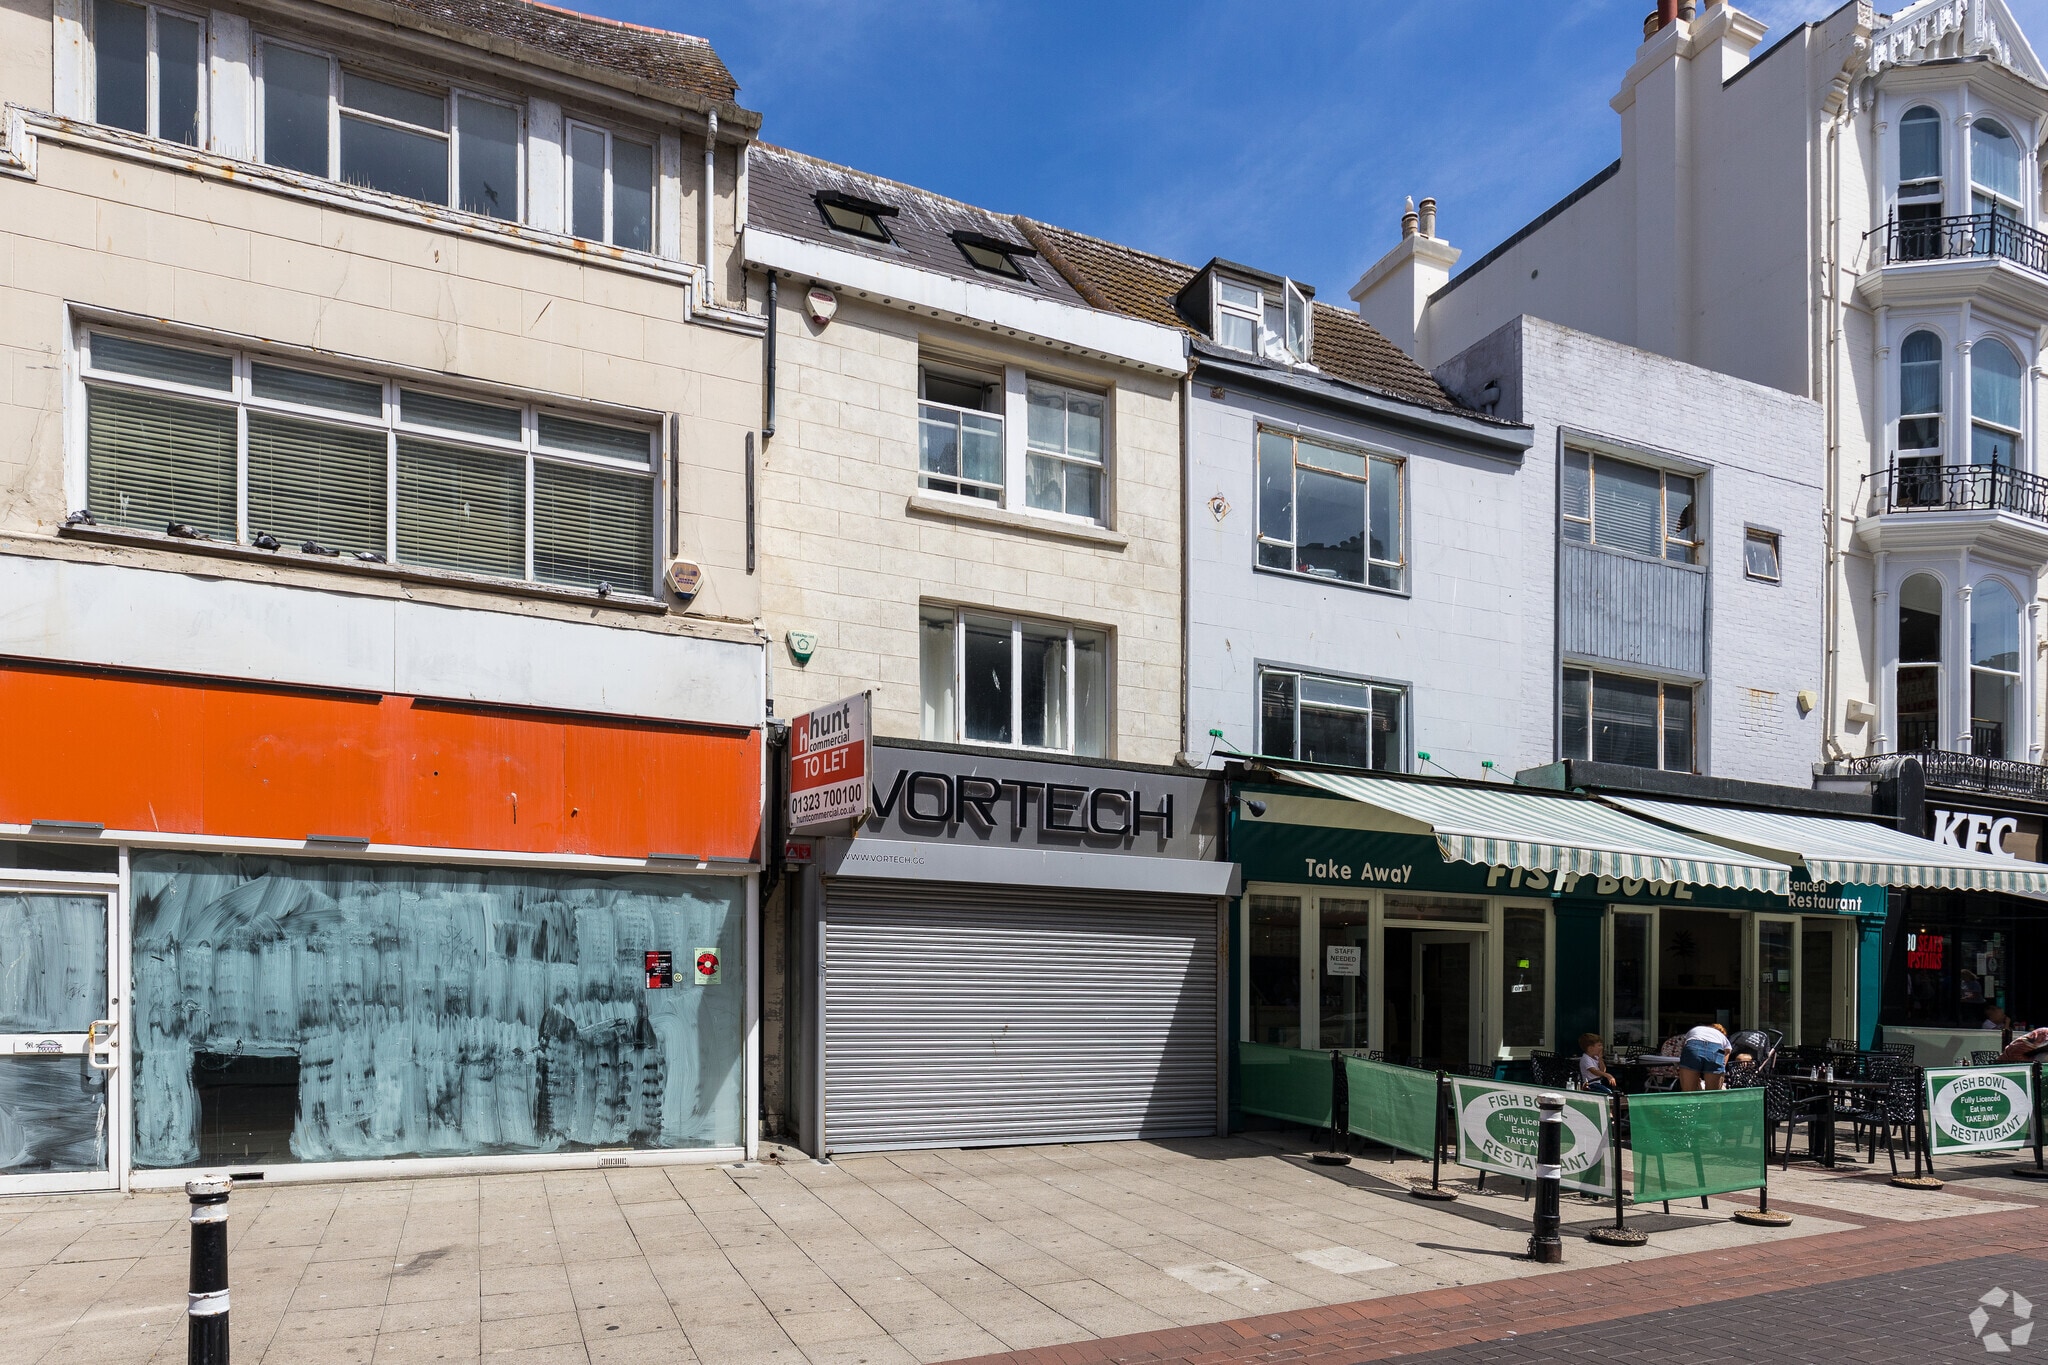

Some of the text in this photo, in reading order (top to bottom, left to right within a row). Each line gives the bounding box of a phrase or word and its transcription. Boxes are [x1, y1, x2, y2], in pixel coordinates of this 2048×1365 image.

[810, 703, 850, 740] hunt
[810, 729, 850, 752] commercial
[803, 747, 849, 778] TO LET
[792, 783, 862, 814] 01323 700100
[872, 769, 1174, 839] VORTECH
[796, 804, 857, 824] huntcommercial.co.uk
[1934, 809, 2017, 859] KFC
[841, 853, 925, 865] WWW.VORTECH.GG
[1305, 858, 1352, 880] Take
[1789, 880, 1827, 893] cenced
[1788, 892, 1862, 911] Restaurant
[1918, 935, 1943, 953] SEATS
[1330, 955, 1357, 963] NEEDED
[1953, 1076, 2007, 1094] FISH BOWL
[1488, 1094, 1519, 1108] FISH
[1960, 1096, 1975, 1105] Fully
[1970, 1105, 1979, 1113] Eat
[1498, 1113, 1519, 1125] Fully
[1982, 1114, 1999, 1122] AWAY
[1511, 1125, 1525, 1135] Eat
[1527, 1127, 1535, 1136] in
[1950, 1115, 2020, 1142] RESTAURANT
[1505, 1136, 1528, 1146] TAKE
[1483, 1139, 1589, 1172] RESTAANT
